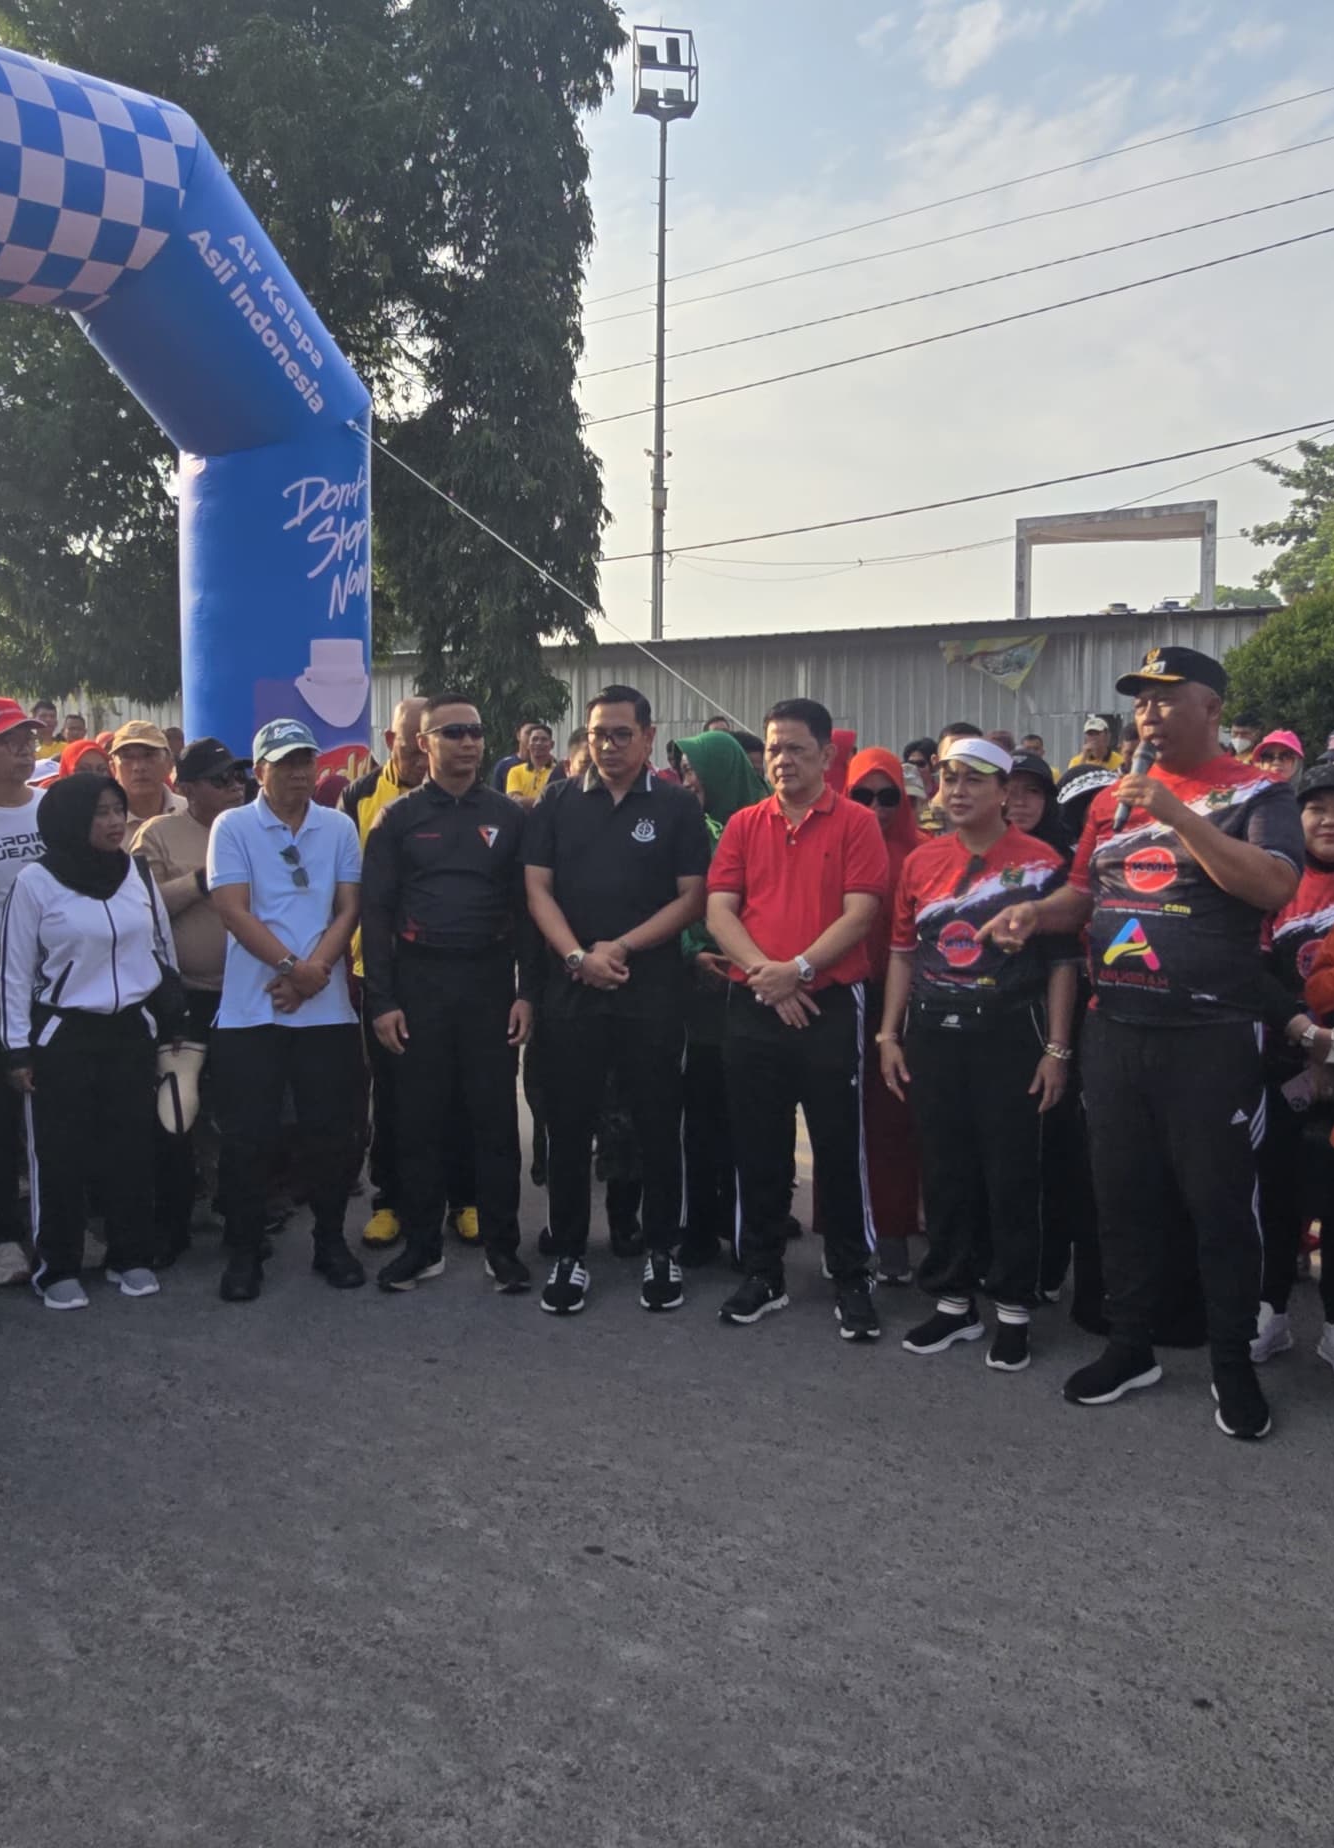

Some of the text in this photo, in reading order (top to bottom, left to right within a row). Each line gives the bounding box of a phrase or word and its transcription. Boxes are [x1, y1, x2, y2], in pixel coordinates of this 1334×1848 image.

[187, 229, 324, 415] Asli Indonesia
[228, 235, 324, 369] Air Kelapa
[307, 515, 367, 579] Stop
